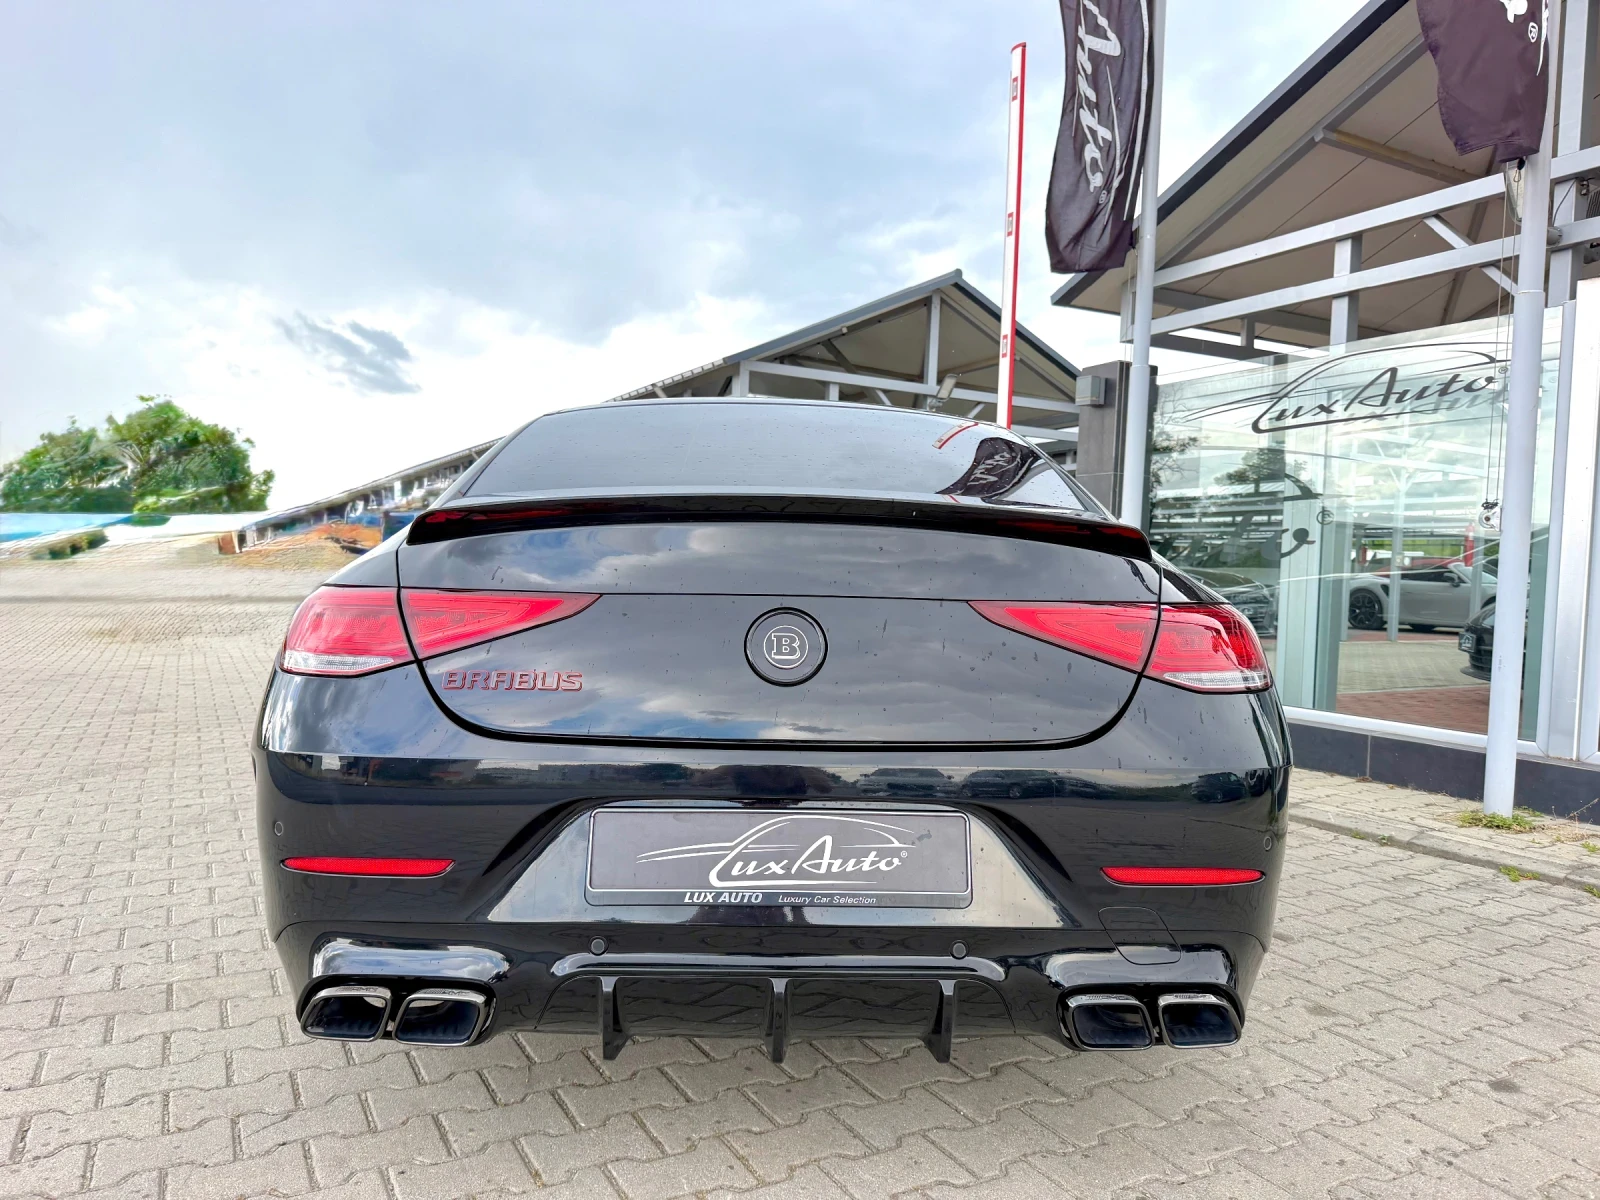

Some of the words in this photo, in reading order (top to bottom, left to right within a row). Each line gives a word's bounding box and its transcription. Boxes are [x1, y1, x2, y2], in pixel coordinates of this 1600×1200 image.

[771, 632, 801, 660] B
[442, 669, 583, 692] BRABUS
[683, 892, 716, 904] LUX
[717, 892, 763, 904] AUTO
[778, 894, 811, 905] Luxury
[813, 895, 831, 904] Car
[834, 895, 877, 905] Selection
